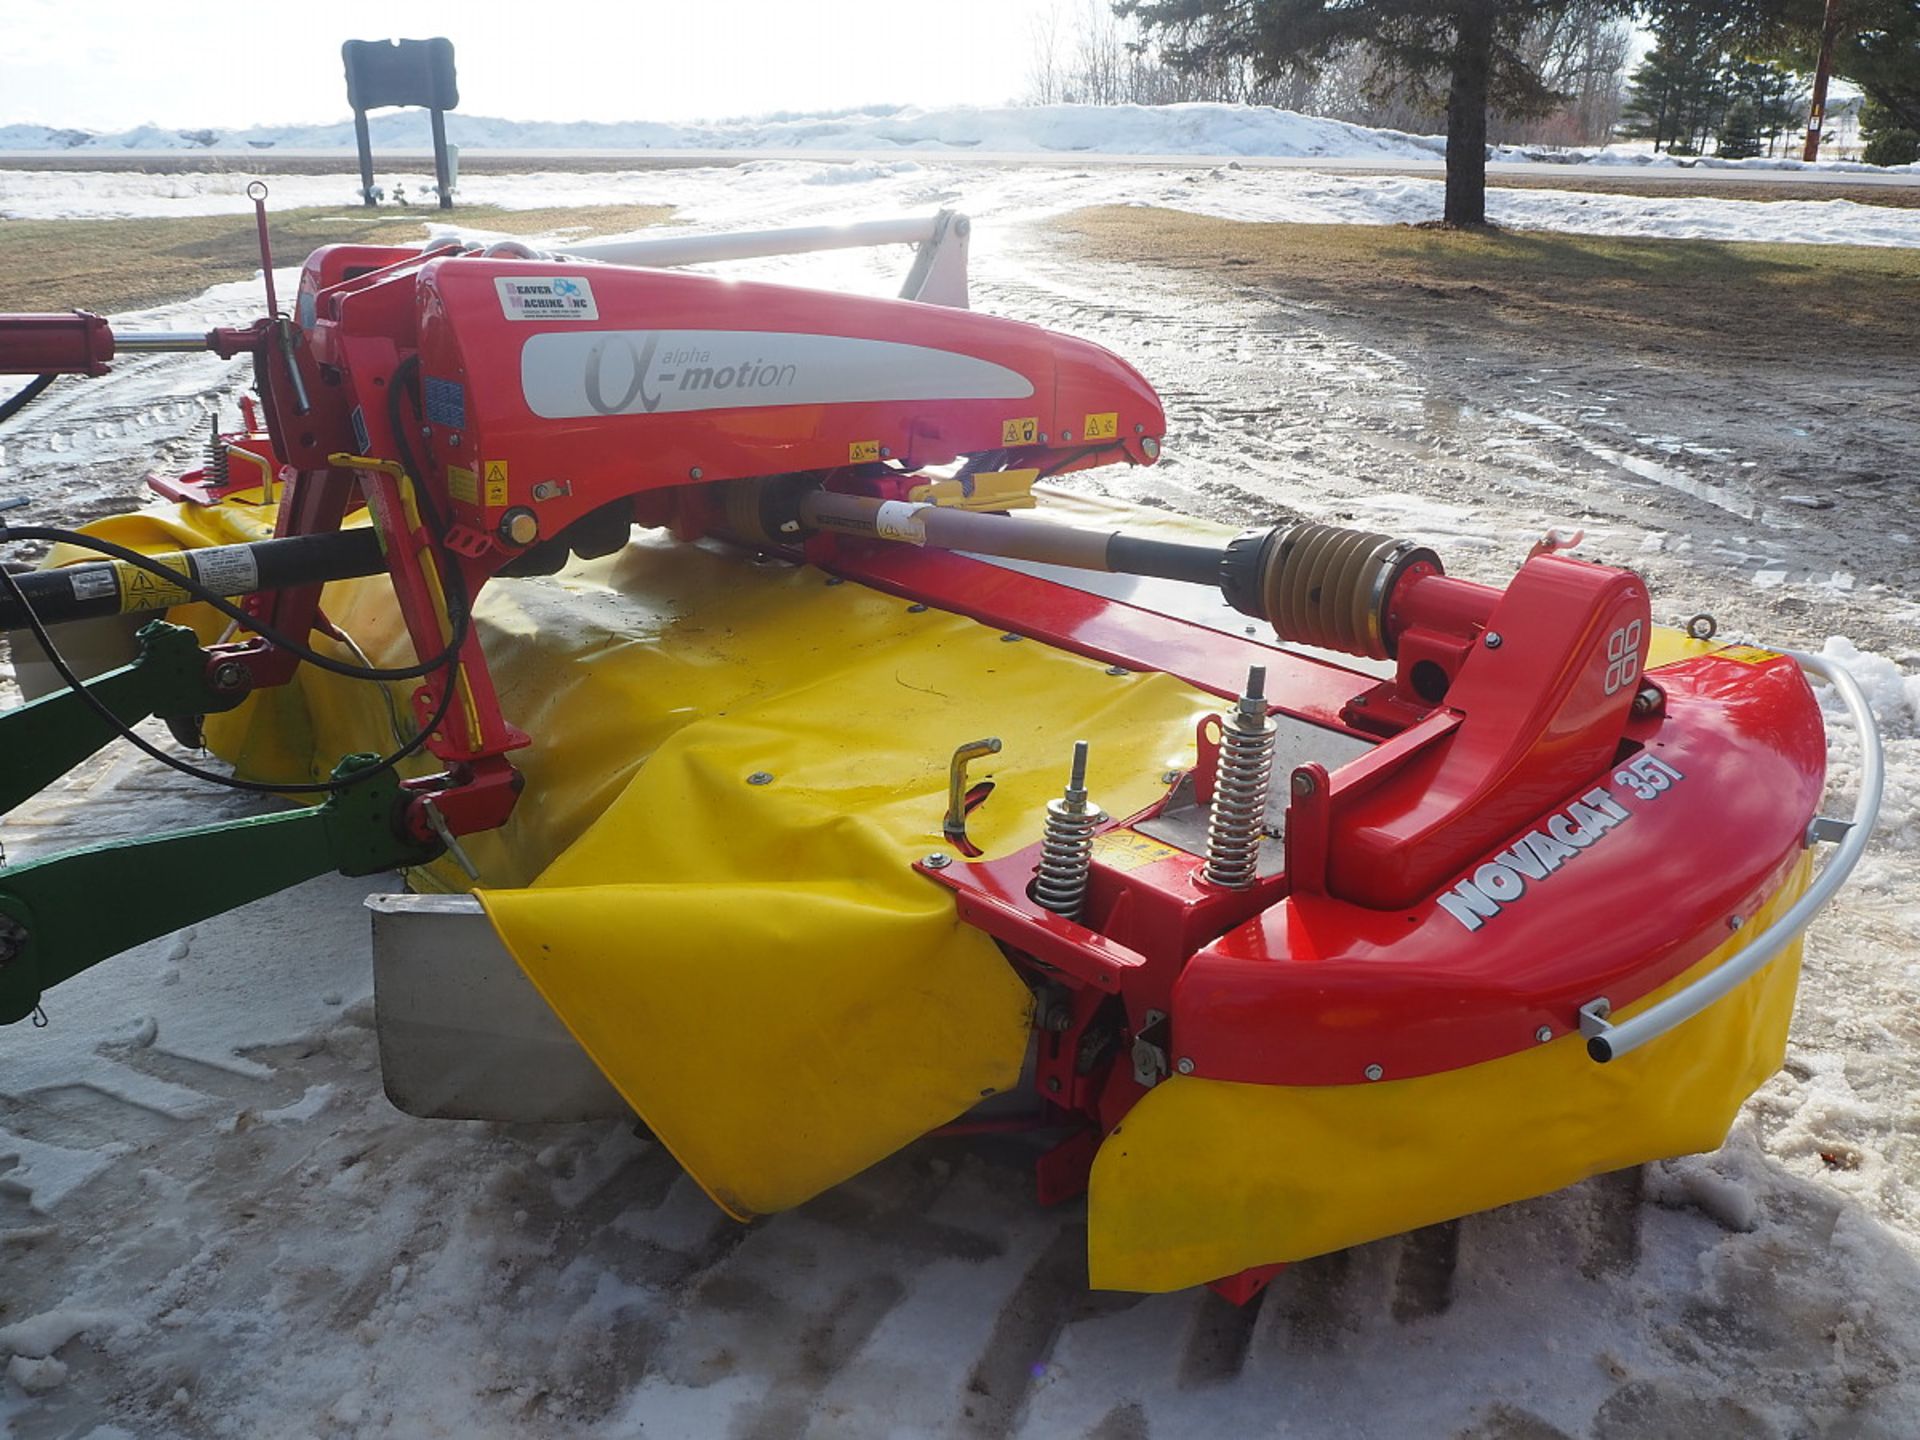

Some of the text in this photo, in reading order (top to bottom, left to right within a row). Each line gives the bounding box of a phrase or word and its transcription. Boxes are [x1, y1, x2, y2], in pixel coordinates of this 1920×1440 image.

[505, 282, 552, 294] BEAVER
[510, 296, 564, 308] MACHINE
[662, 347, 711, 366] alpha
[1436, 753, 1686, 932] NOVACAT 351
